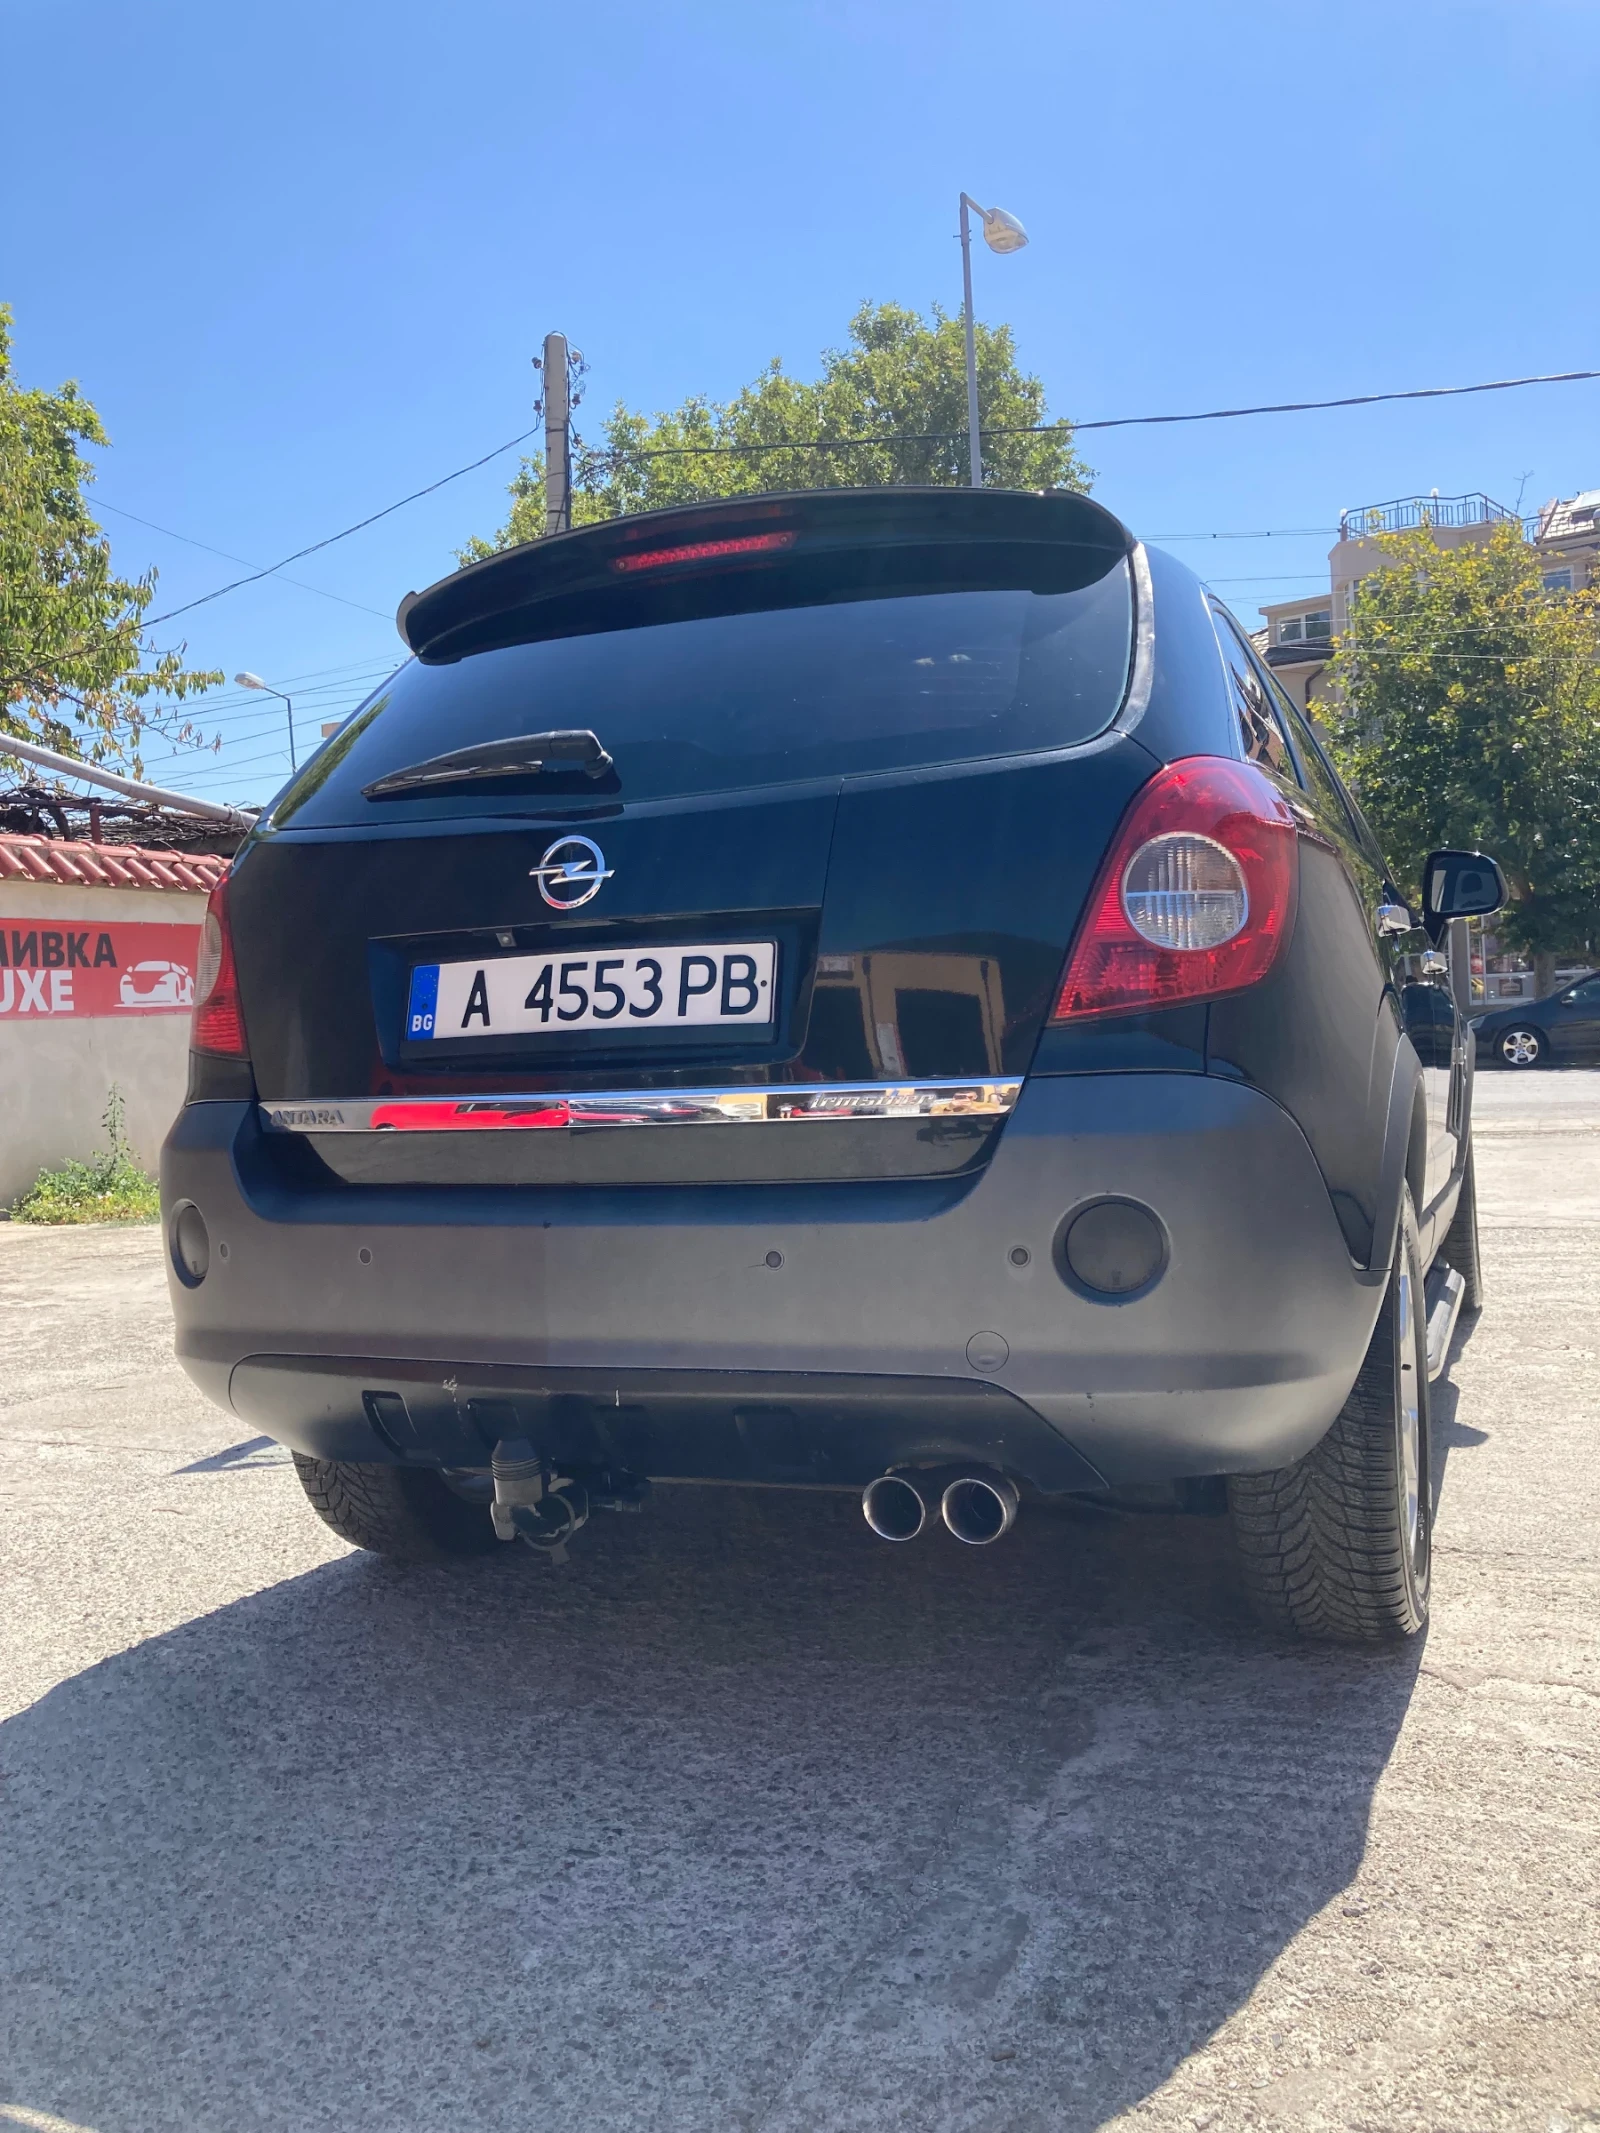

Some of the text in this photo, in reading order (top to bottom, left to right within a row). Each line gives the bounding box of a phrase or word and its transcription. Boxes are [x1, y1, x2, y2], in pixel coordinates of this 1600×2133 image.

[461, 954, 760, 1028] A 4553 PB
[411, 1014, 433, 1032] BG
[271, 1109, 345, 1126] ANTARA
